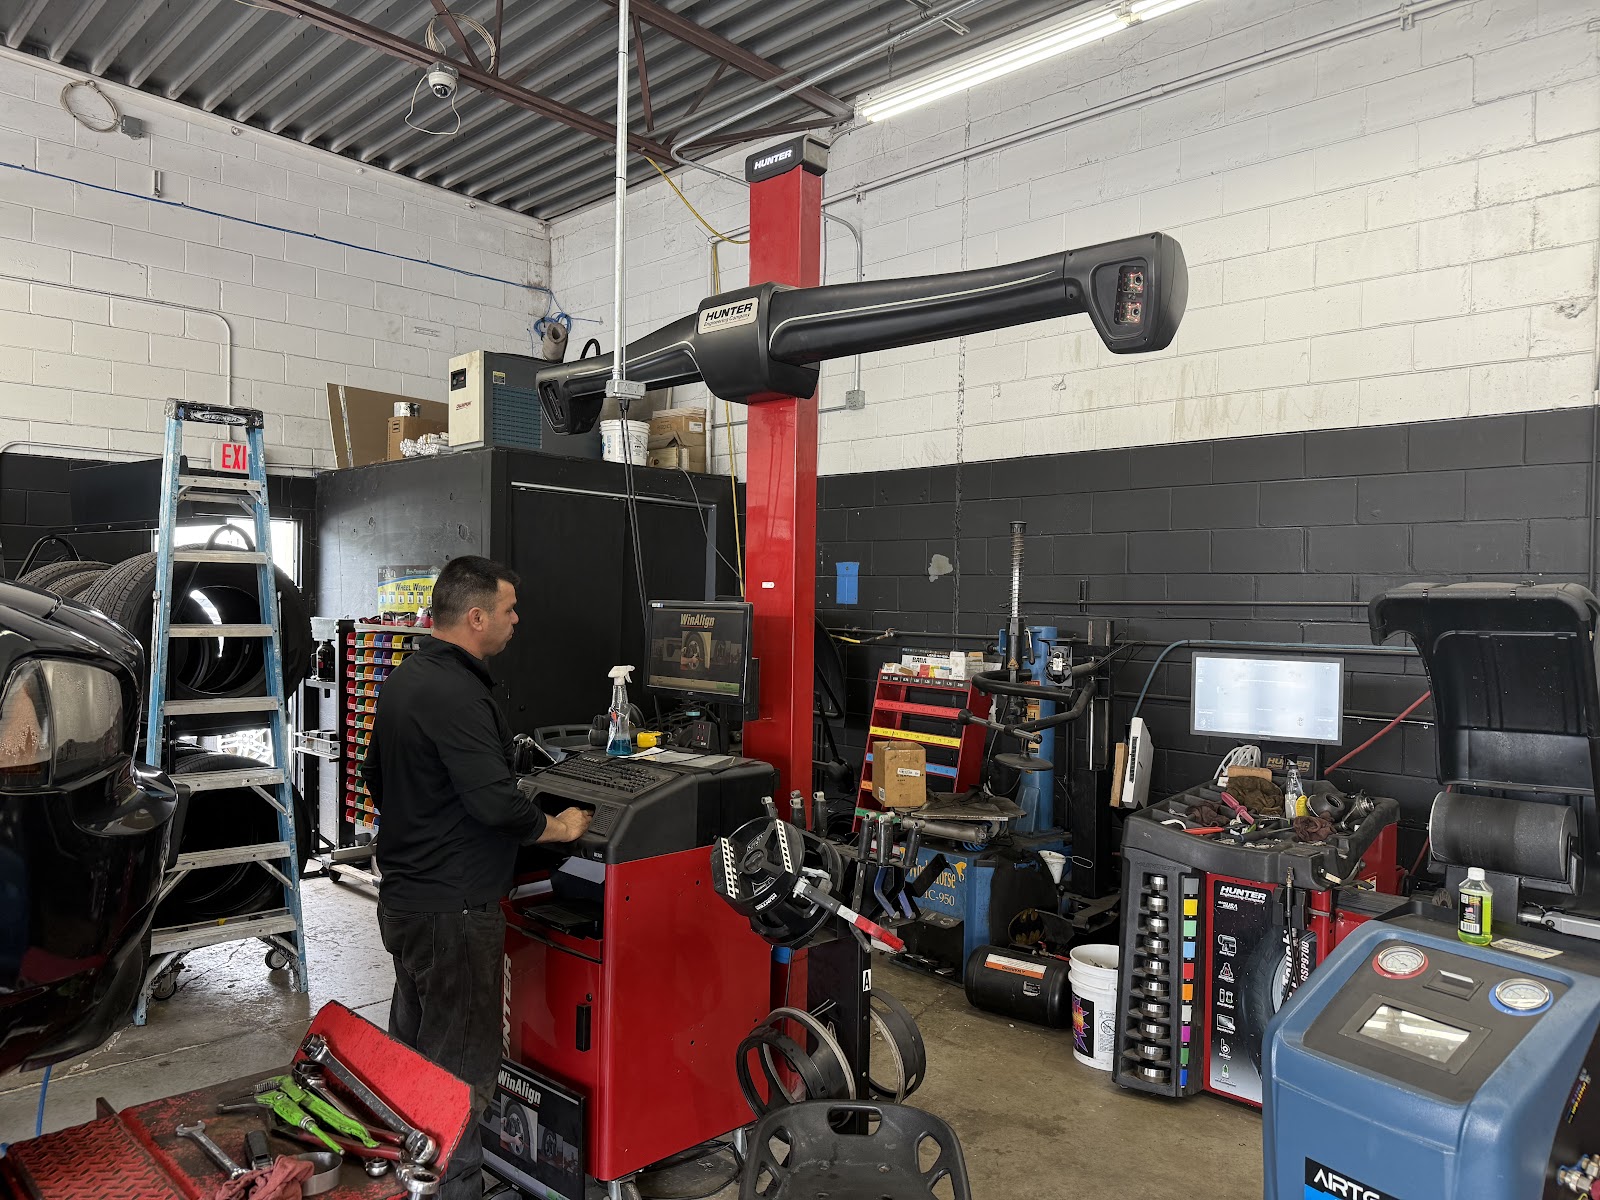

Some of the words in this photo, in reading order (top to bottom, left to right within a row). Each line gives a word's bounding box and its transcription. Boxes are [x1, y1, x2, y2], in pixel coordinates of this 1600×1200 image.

[754, 149, 792, 170] HUNTER
[706, 303, 753, 321] HUNTER
[222, 443, 247, 470] EXI
[681, 613, 715, 628] WinAlign
[1266, 757, 1311, 768] HUER
[1220, 886, 1267, 901] HUNTER
[1300, 941, 1310, 982] GSP9700
[864, 971, 870, 990] A
[502, 953, 512, 1062] UNTER
[498, 1070, 541, 1104] WinAlign
